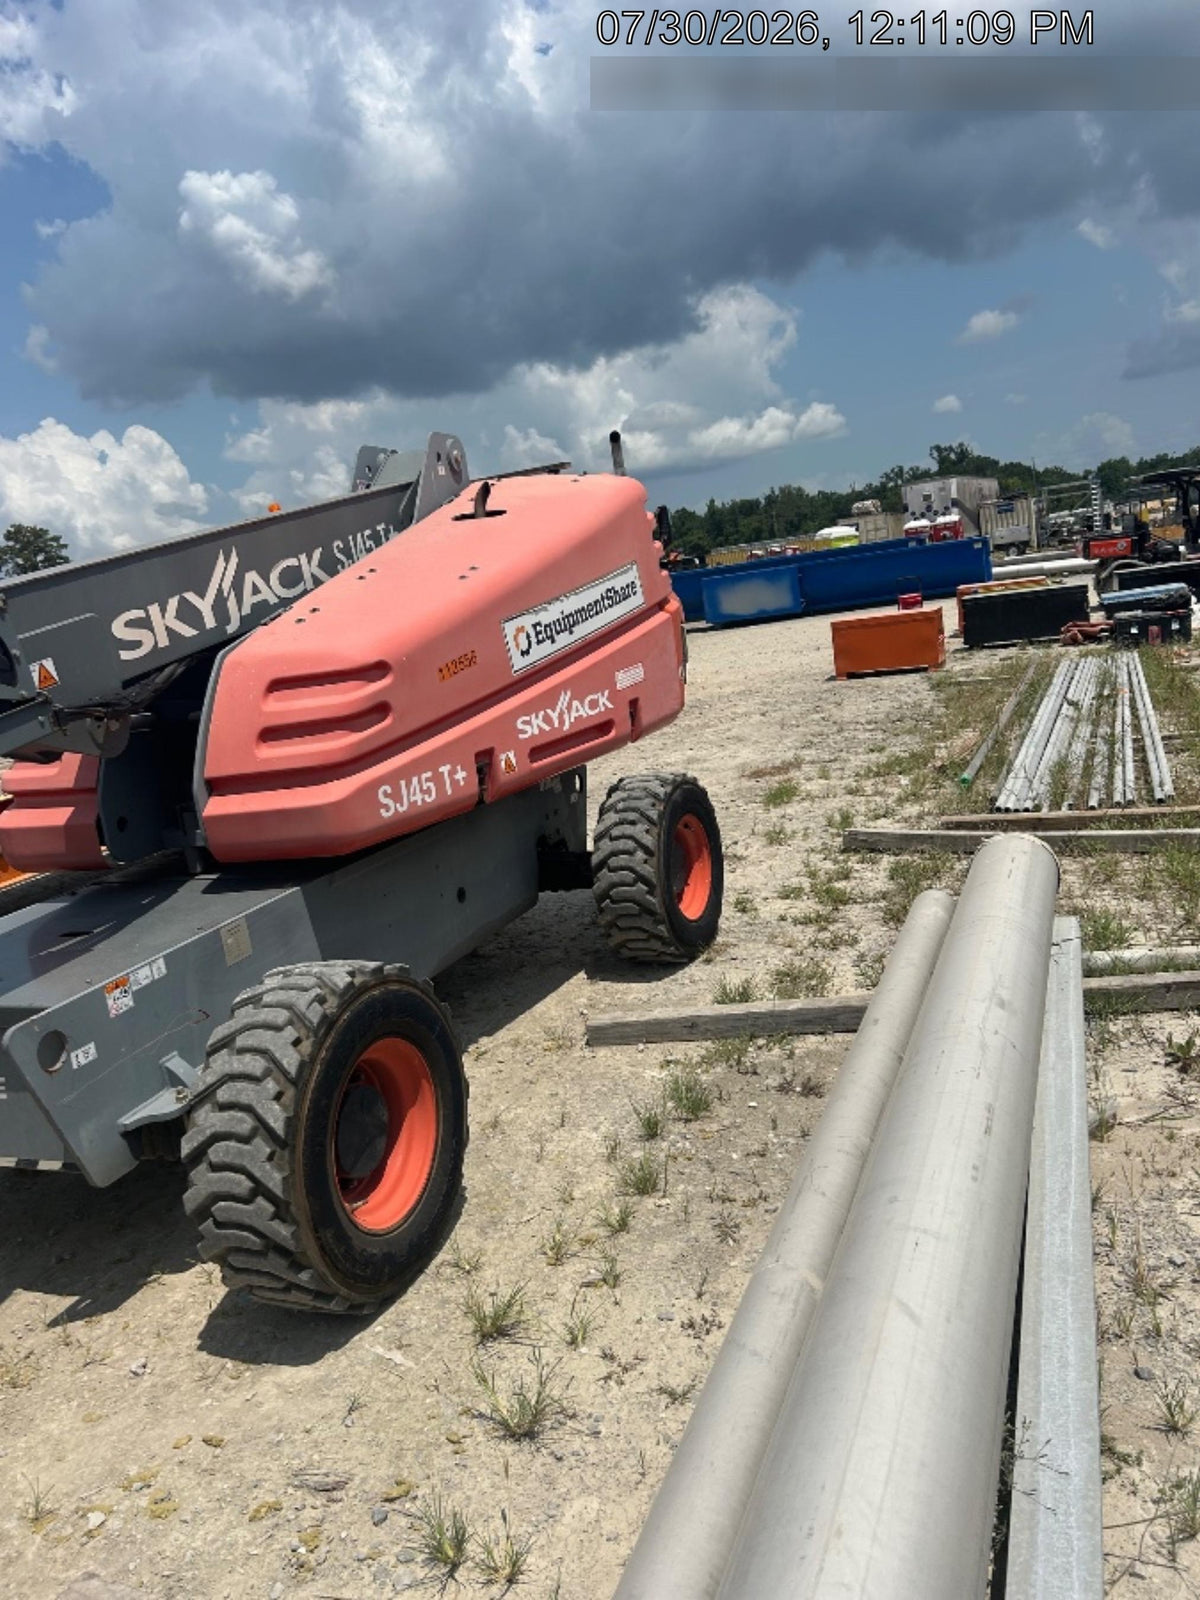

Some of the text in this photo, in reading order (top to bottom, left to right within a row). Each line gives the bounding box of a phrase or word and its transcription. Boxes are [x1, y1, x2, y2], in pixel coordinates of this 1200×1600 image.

[111, 545, 331, 661] SKYJACK
[531, 580, 638, 646] EquipmentShare
[516, 689, 614, 739] SKYJACK
[378, 764, 468, 818] SJ45 T+
